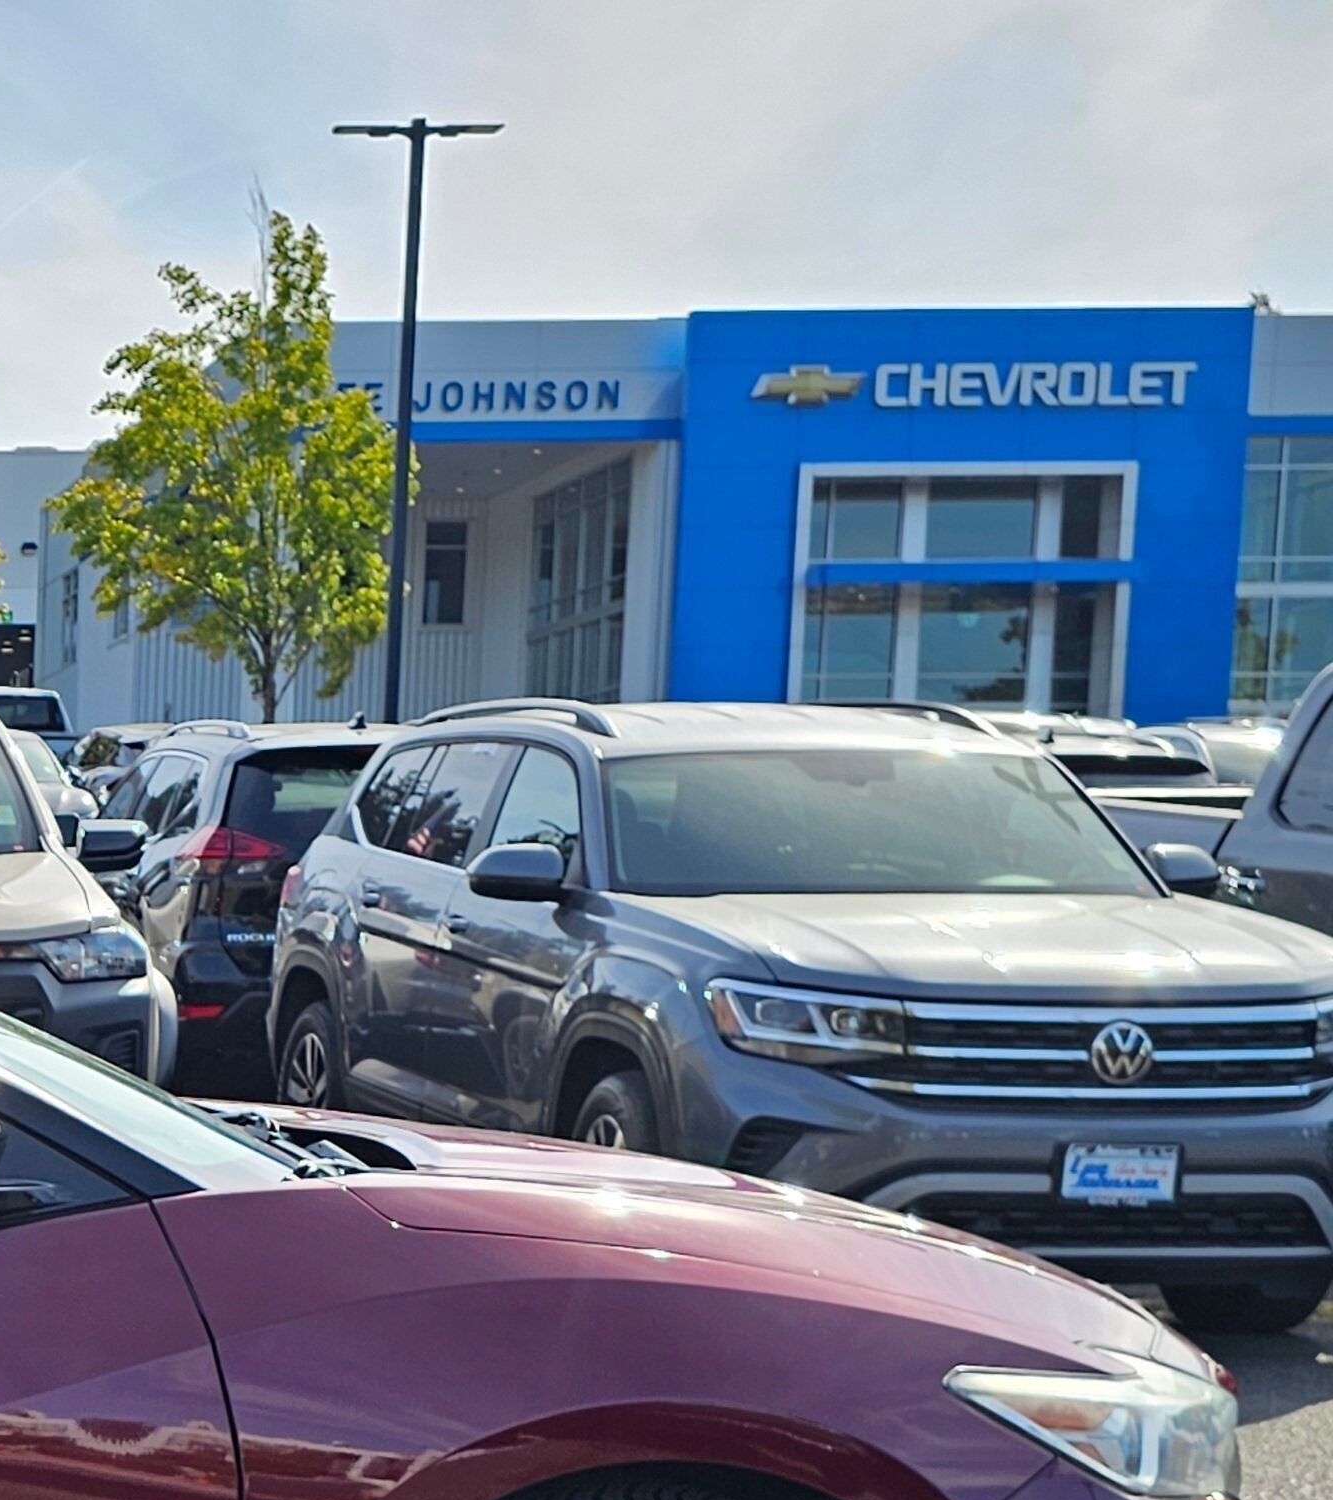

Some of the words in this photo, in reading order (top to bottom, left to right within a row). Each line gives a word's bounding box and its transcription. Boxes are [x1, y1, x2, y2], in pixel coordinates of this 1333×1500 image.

[412, 380, 621, 412] JOHNSON
[874, 361, 1199, 407] CHEVROLET
[226, 932, 277, 943] ROGU
